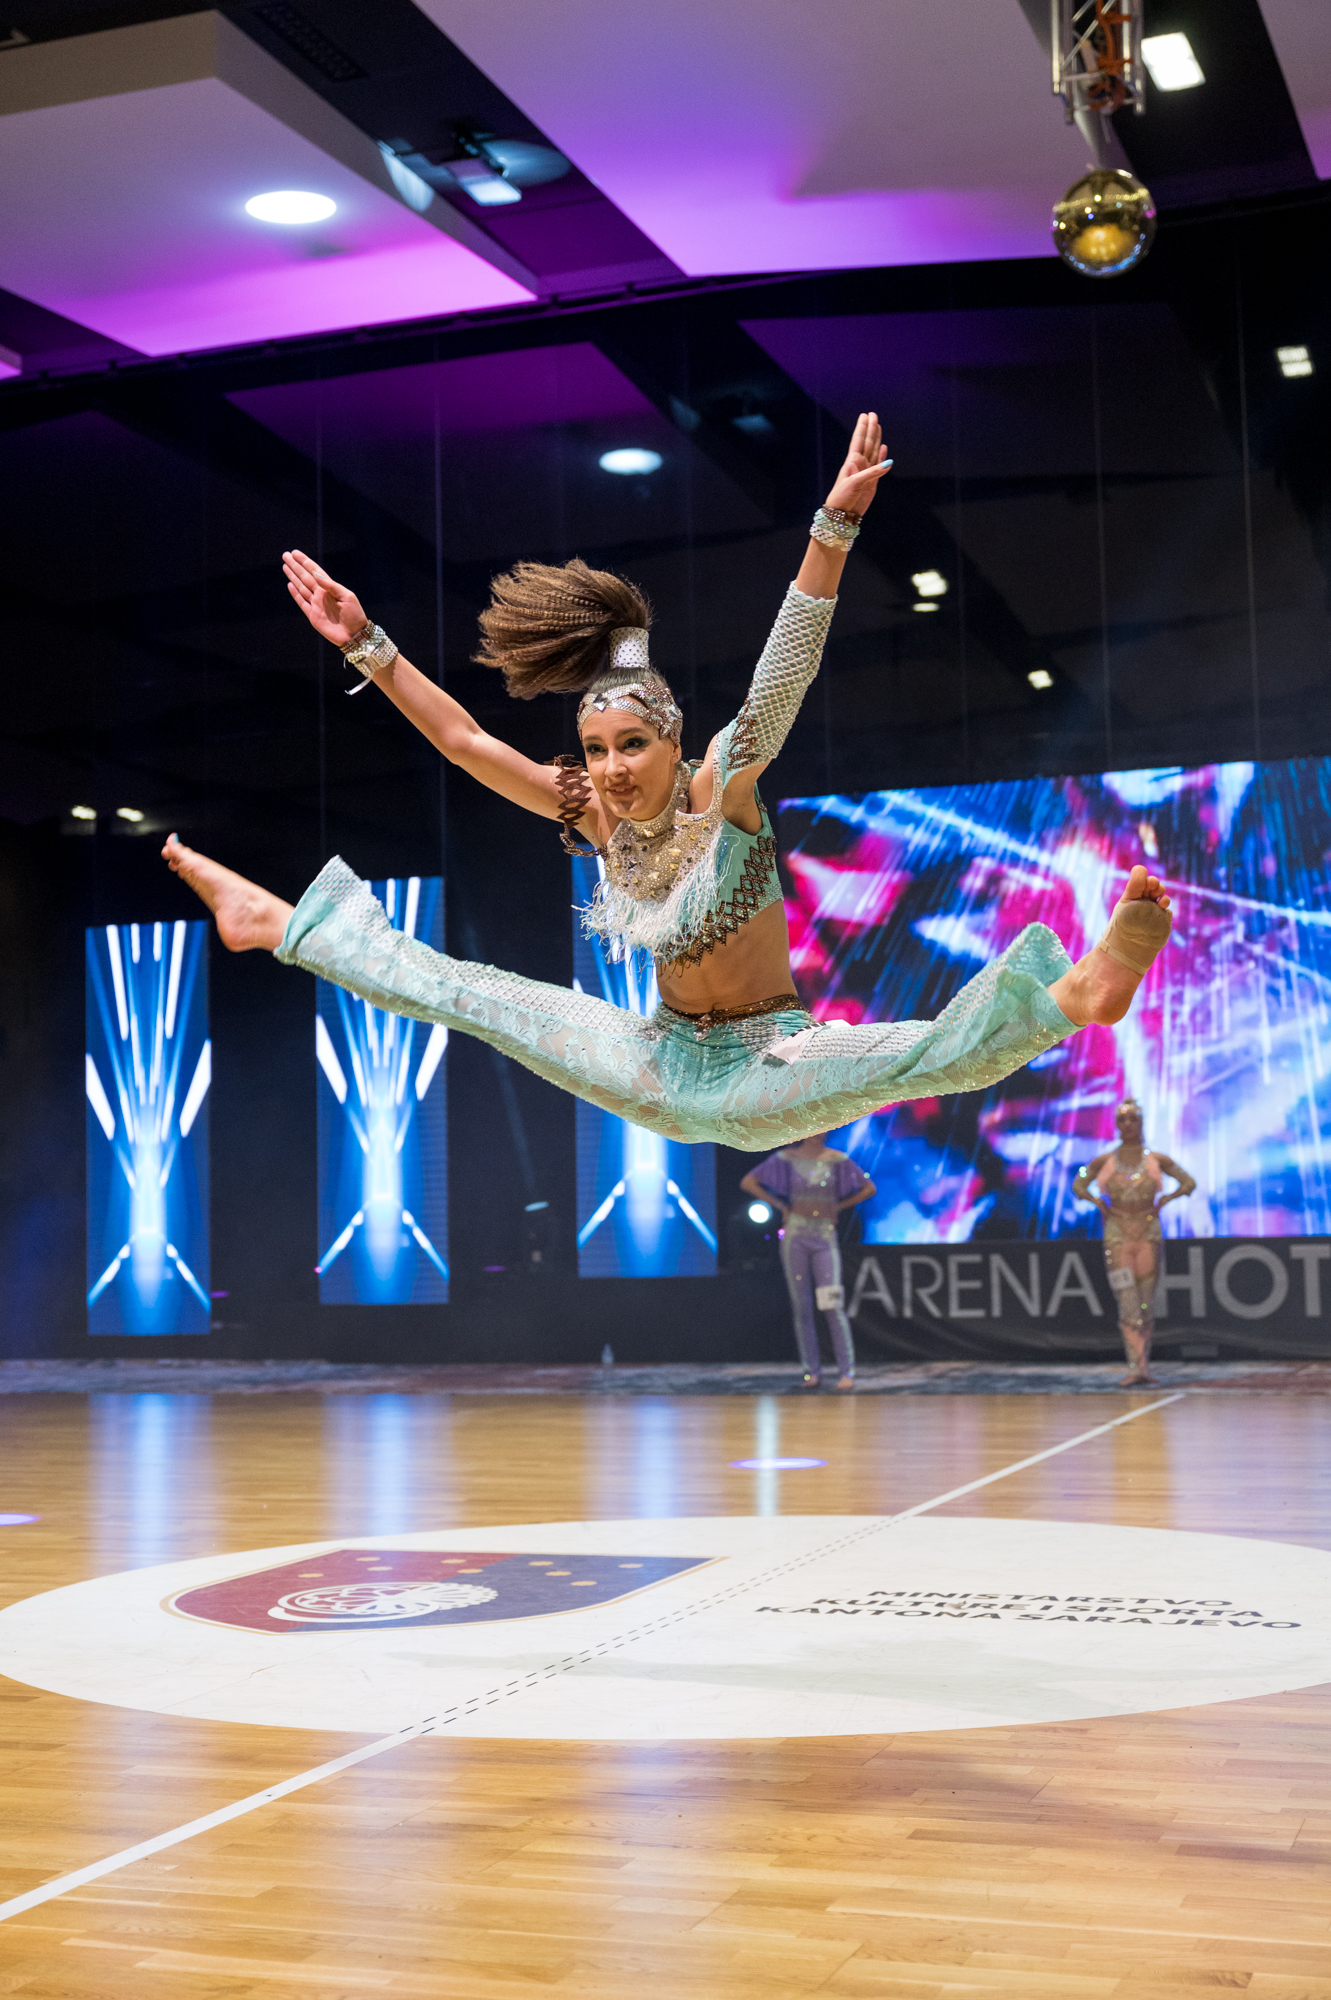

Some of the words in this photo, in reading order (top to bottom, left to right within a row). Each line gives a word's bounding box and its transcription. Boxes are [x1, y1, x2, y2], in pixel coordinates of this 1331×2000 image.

[848, 1252, 1104, 1318] ARENA
[867, 1590, 1232, 1606] MINISTARSTVO
[754, 1606, 1002, 1619] KANTONA
[1014, 1613, 1302, 1628] SARAJEVO
[1062, 1605, 1264, 1617] SPORTA
